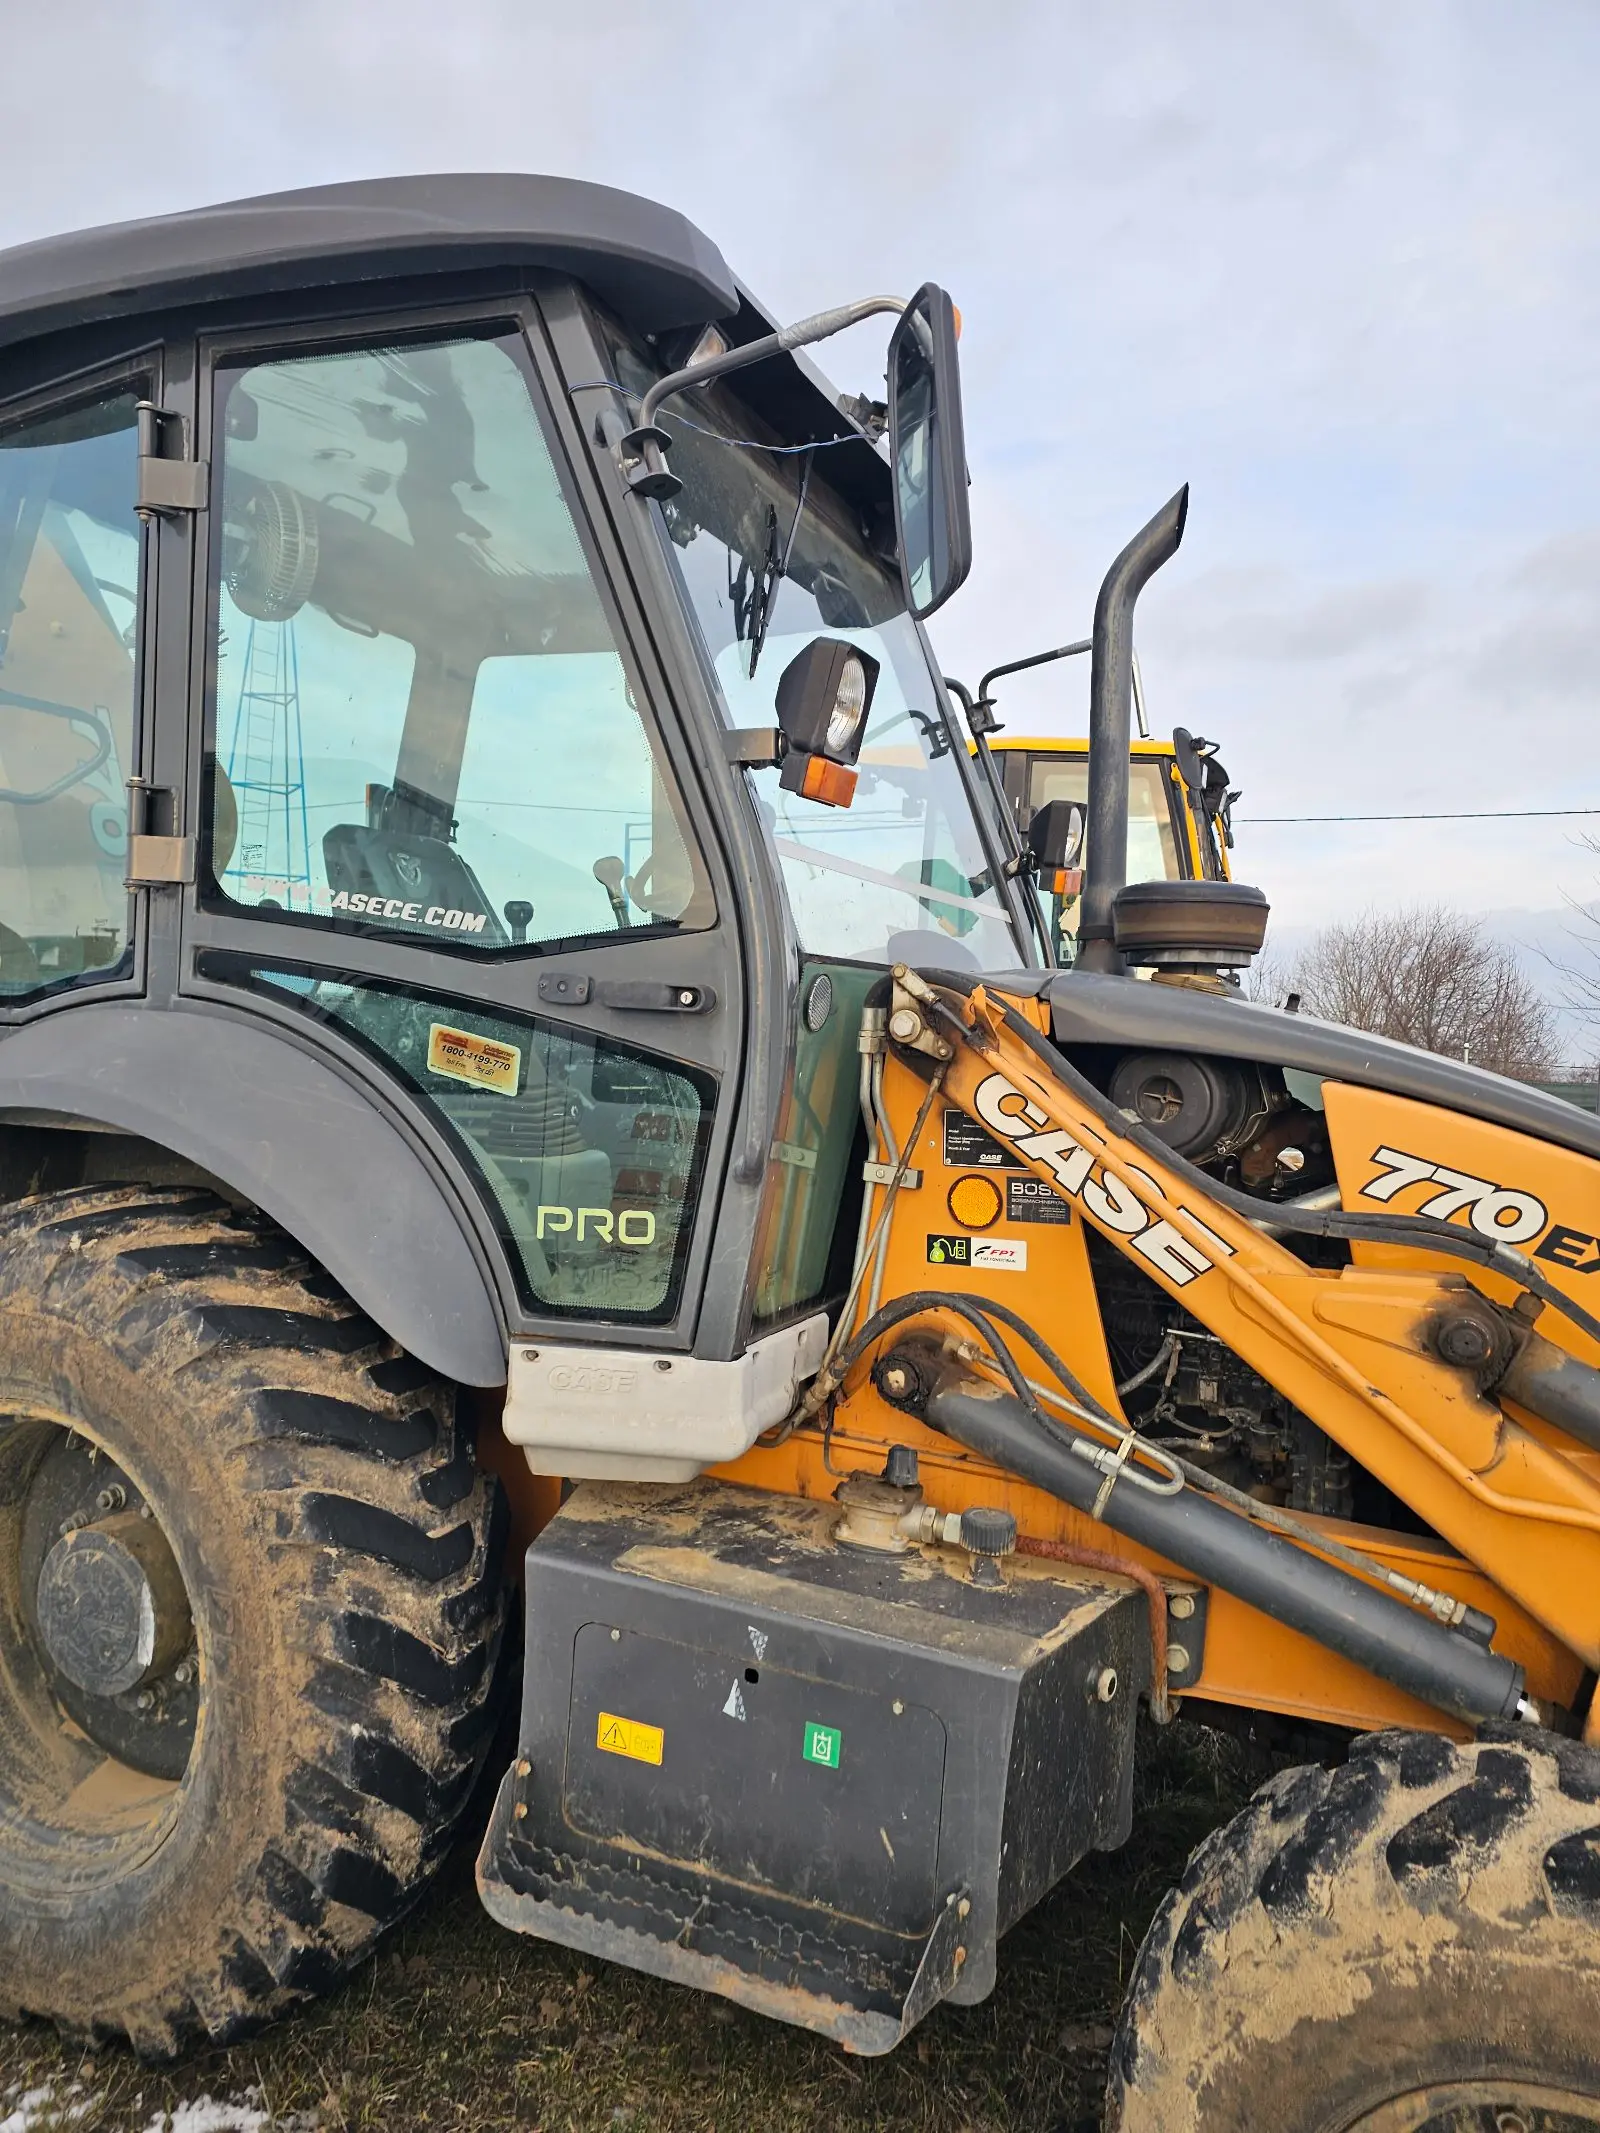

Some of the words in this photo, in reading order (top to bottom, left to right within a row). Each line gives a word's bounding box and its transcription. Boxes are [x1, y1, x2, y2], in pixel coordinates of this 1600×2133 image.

[441, 1044, 511, 1071] 1800-4199-770
[979, 1153, 1003, 1161] CASE
[973, 1071, 1238, 1288] CASE
[1358, 1144, 1549, 1245] 770
[536, 1205, 656, 1246] PRO
[990, 1249, 1017, 1257] FPT
[547, 1364, 639, 1394] CASE
